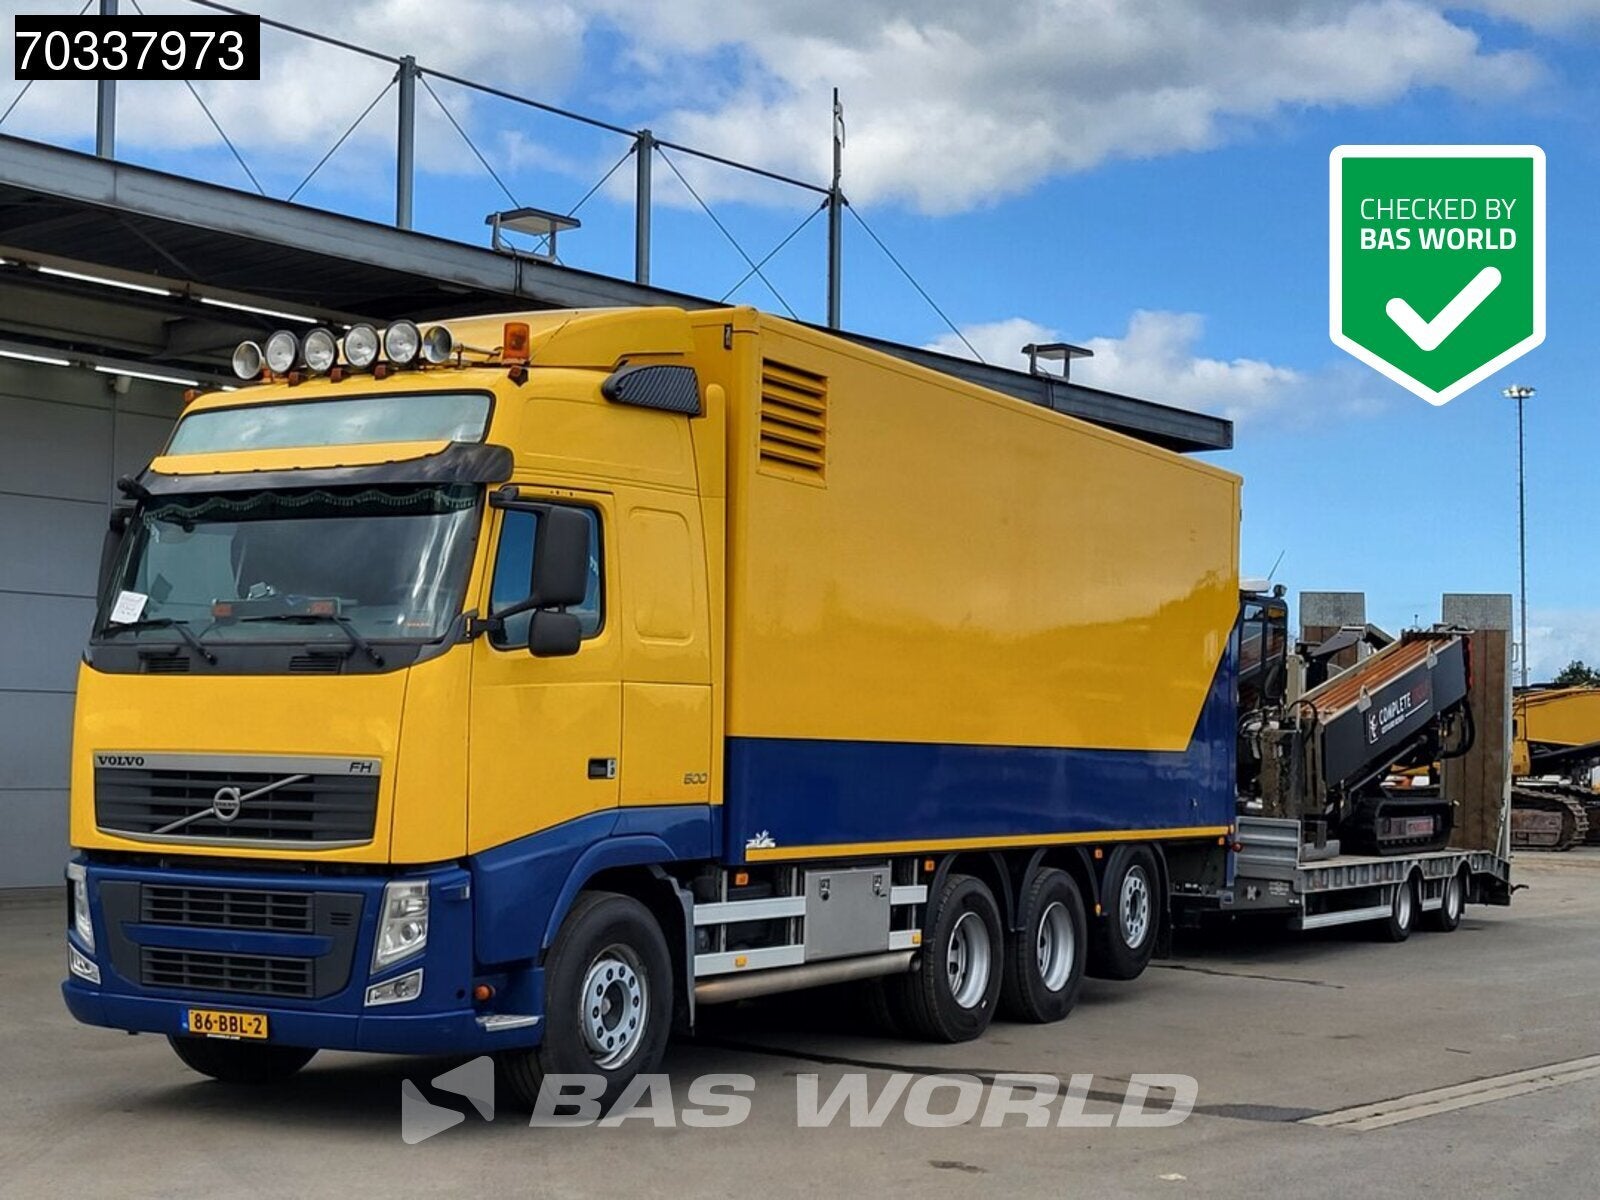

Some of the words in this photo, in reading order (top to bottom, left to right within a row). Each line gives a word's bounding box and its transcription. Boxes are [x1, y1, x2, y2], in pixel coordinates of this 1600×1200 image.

[98, 755, 145, 767] VOLVO
[349, 761, 373, 773] FH
[194, 1013, 262, 1034] 86-BBL-2
